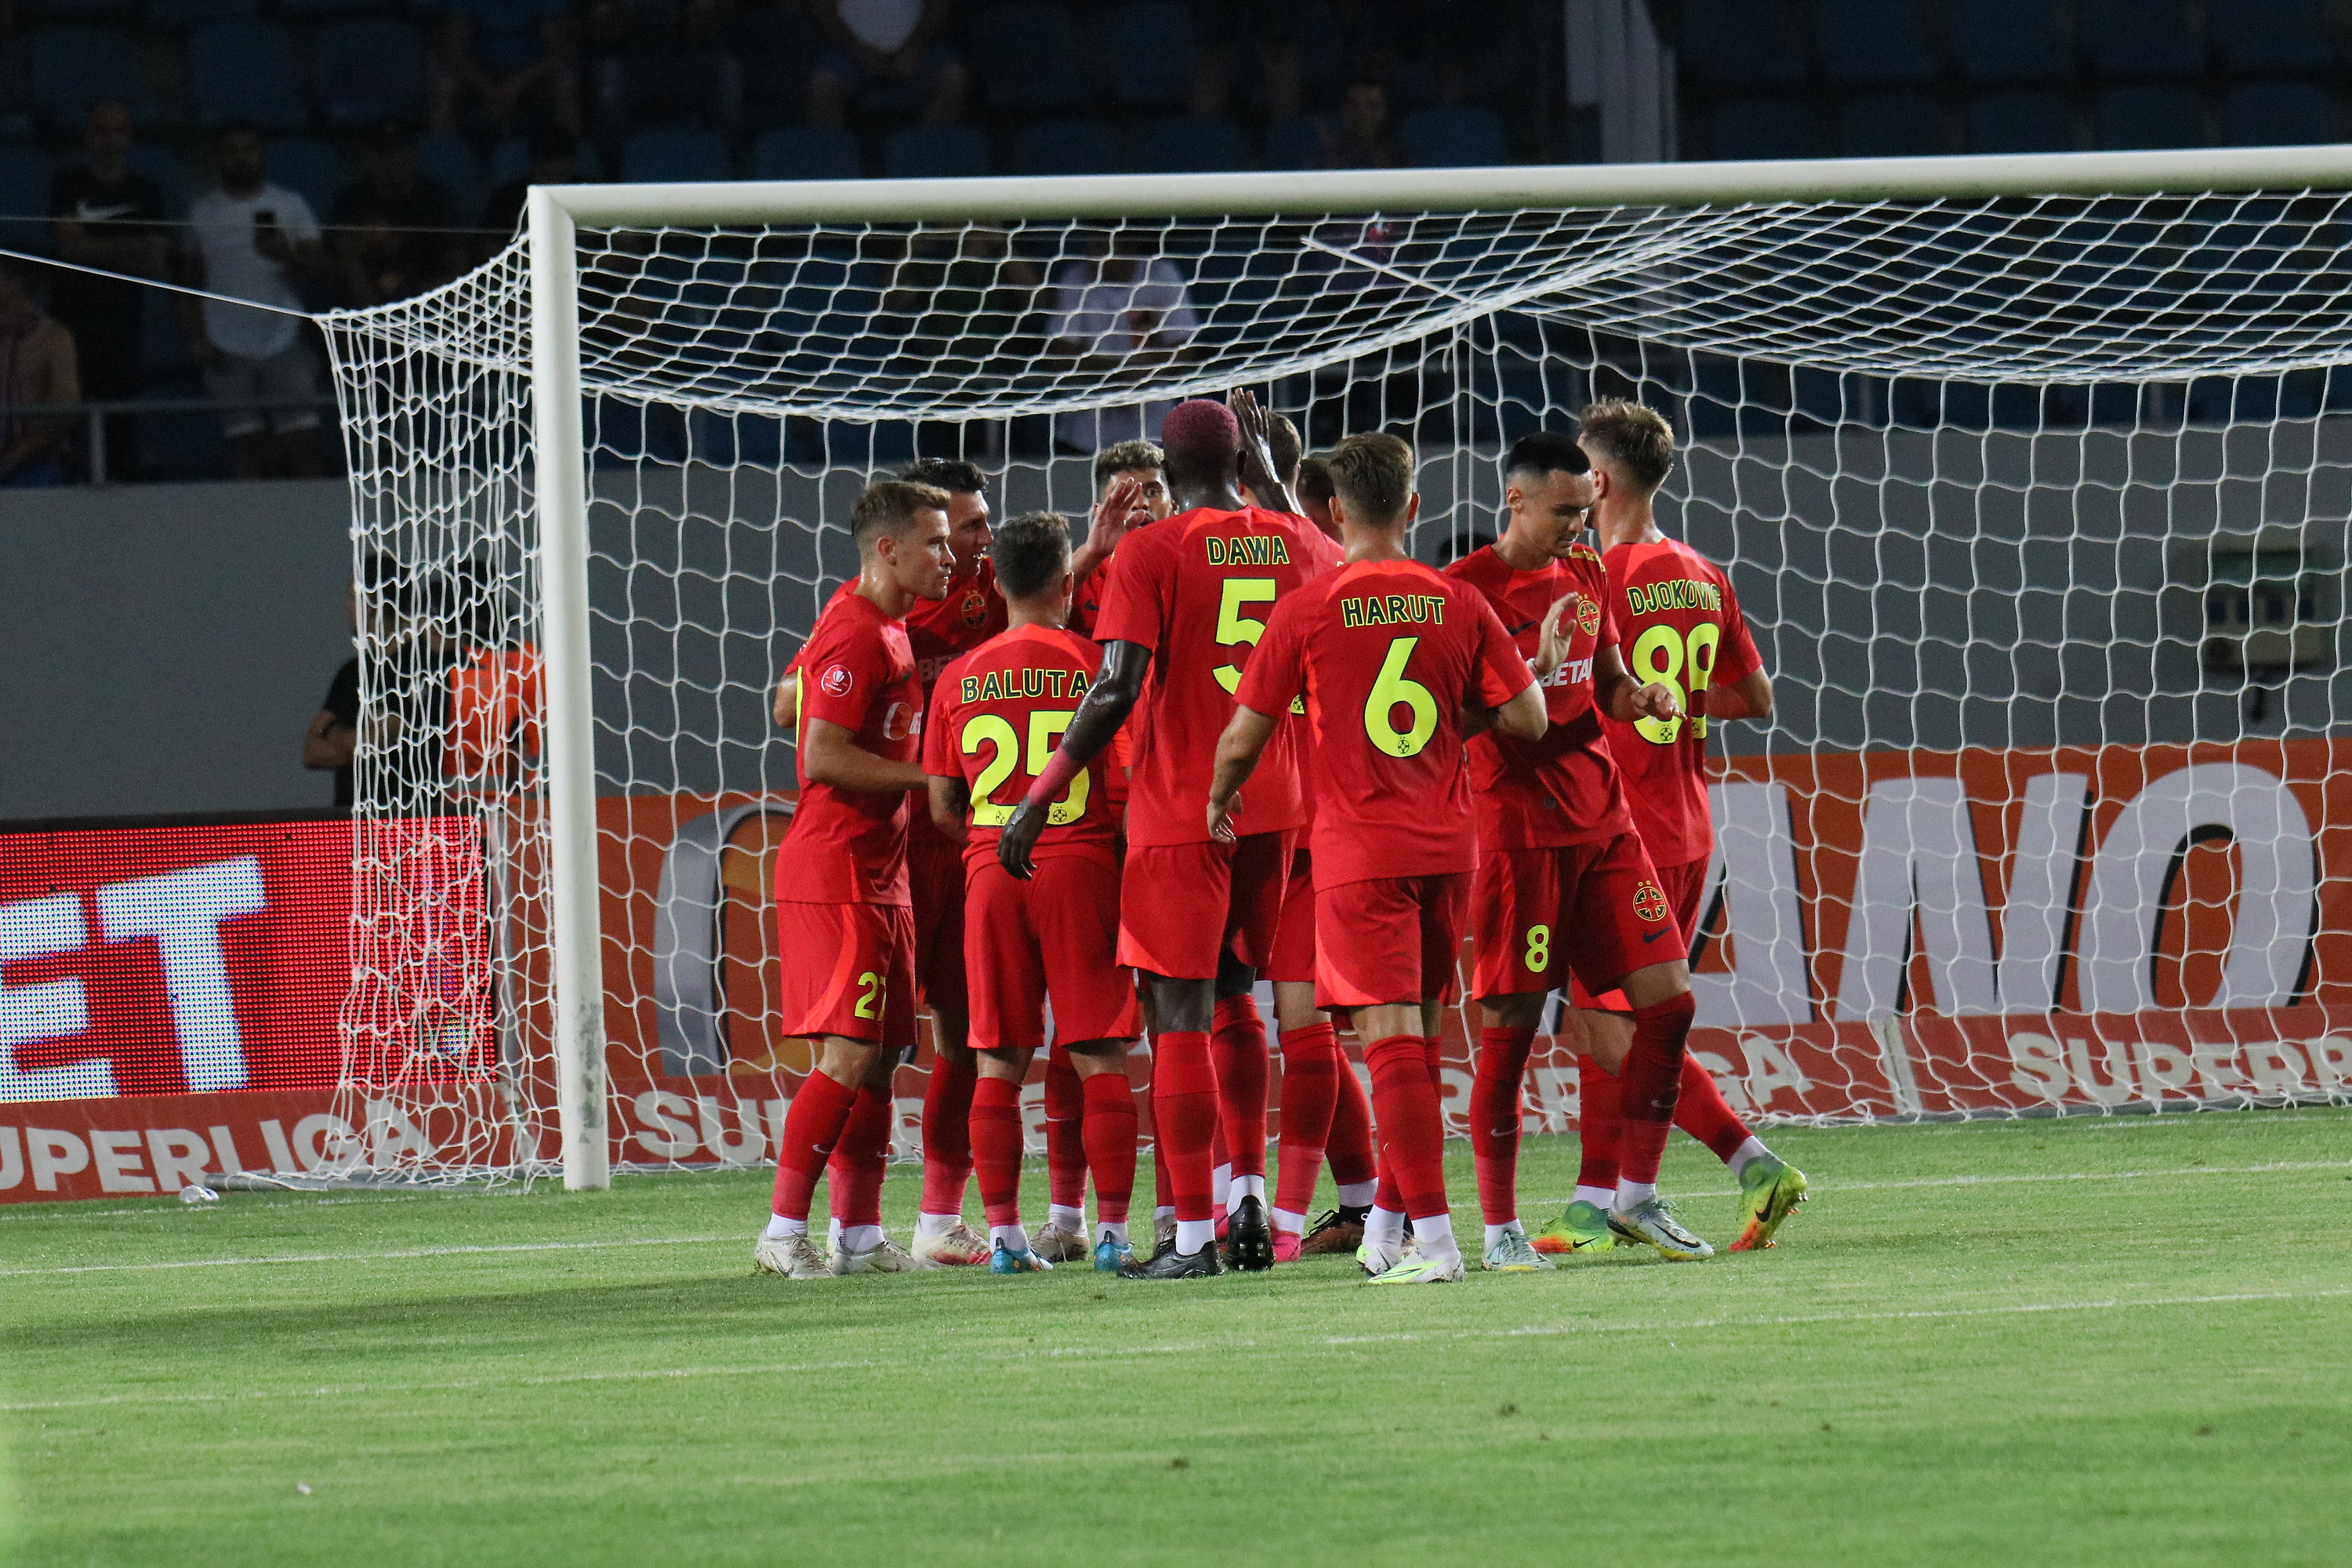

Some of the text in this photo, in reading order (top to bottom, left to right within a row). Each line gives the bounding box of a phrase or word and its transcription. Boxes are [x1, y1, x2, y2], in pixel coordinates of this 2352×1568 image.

[1205, 535, 1290, 565] DAWA
[1341, 594, 1445, 628] HARUT
[1212, 578, 1276, 695] 5
[961, 668, 1089, 704] BALUTA
[1364, 636, 1438, 758] 6
[961, 710, 1091, 826] 25
[1525, 924, 1549, 973] 8
